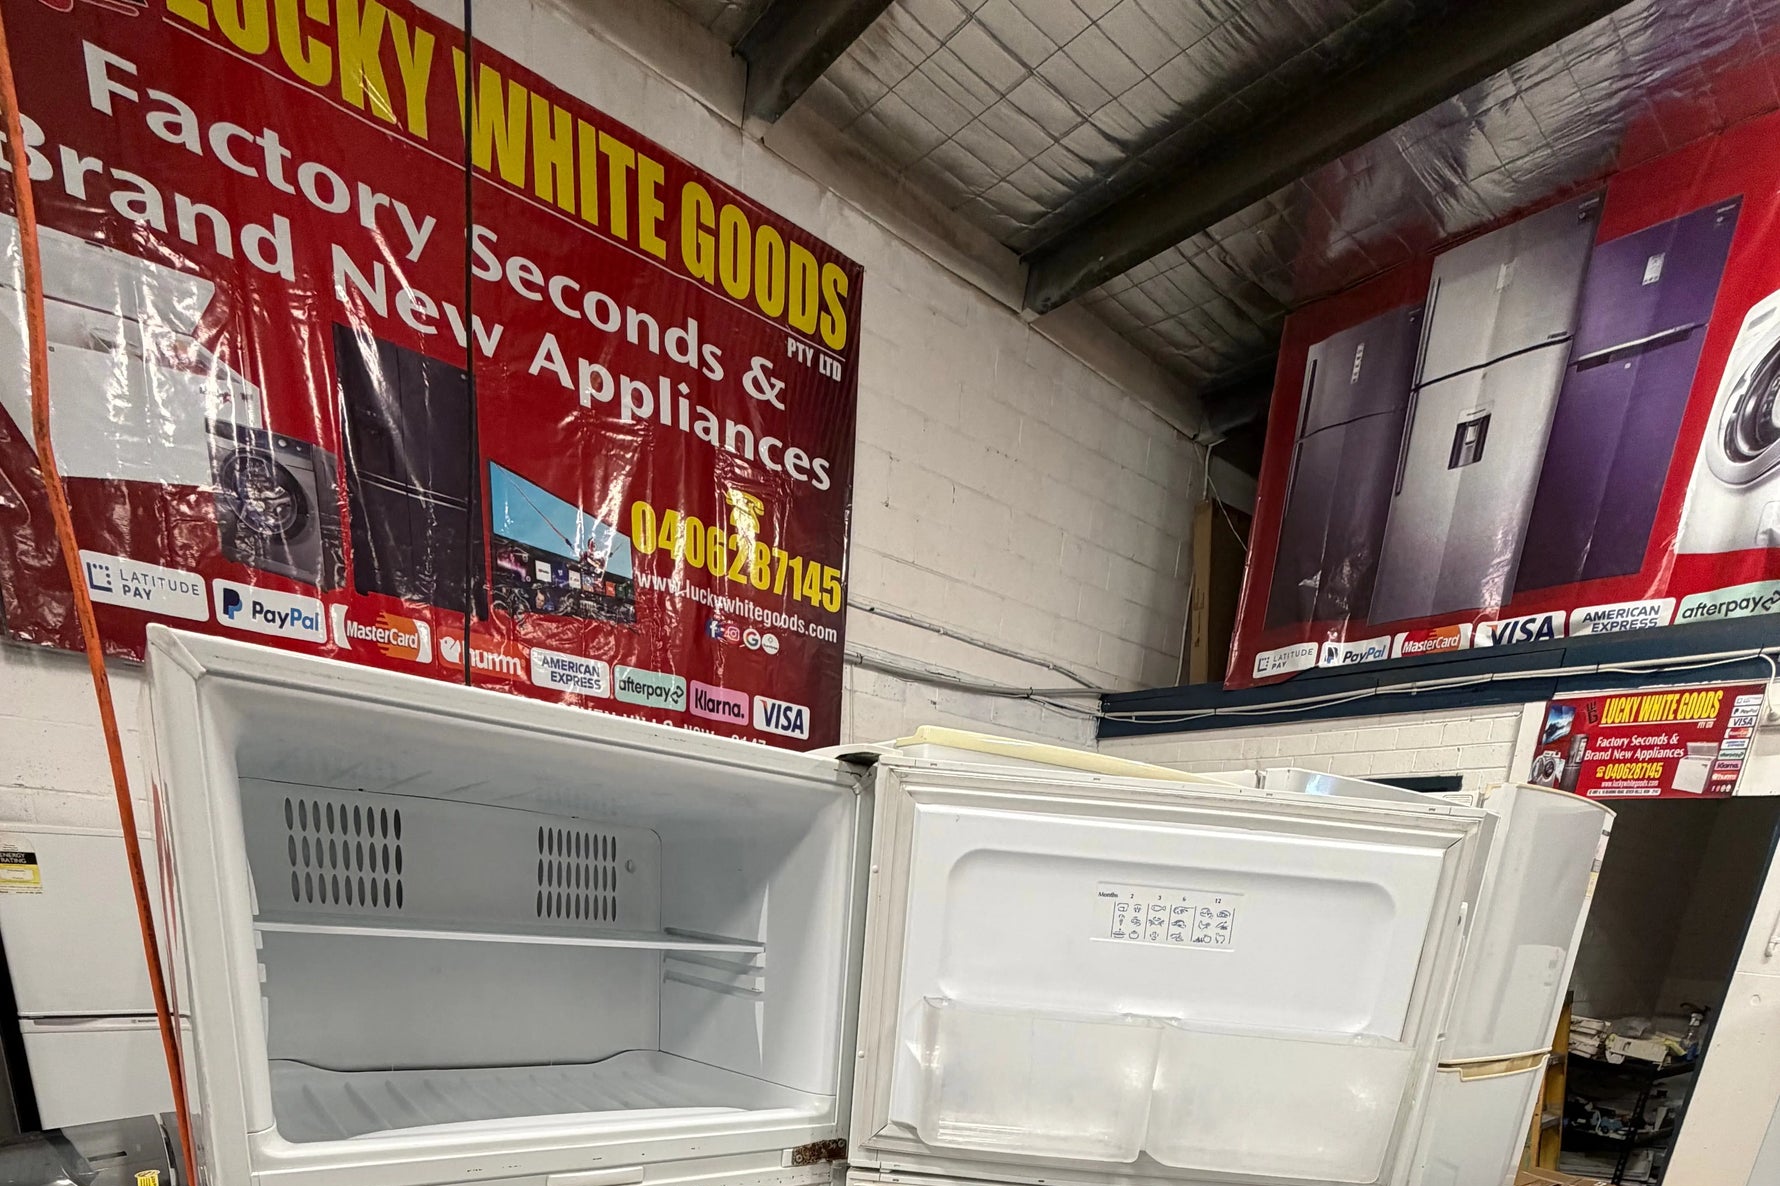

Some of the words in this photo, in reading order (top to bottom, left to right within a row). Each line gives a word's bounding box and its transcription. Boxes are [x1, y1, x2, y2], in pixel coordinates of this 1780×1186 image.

[166, 0, 435, 140] CKY
[452, 46, 666, 260] WHITE
[681, 181, 848, 350] GOODS
[82, 39, 437, 263] Factory
[465, 223, 725, 381] Seconds
[742, 355, 786, 410] &
[0, 111, 296, 282] Brand
[331, 243, 503, 358] New
[528, 333, 831, 490] Appliances
[787, 336, 814, 367] PTY
[819, 355, 842, 381] LTD
[631, 500, 842, 613] 0406287145
[120, 568, 200, 596] LATITUDE
[123, 584, 152, 601] PAY
[252, 600, 319, 631] PayPal
[636, 569, 837, 643] www.luckywhitegoods.com
[1582, 605, 1660, 623] AMERICAN
[1682, 594, 1763, 620] afterpay
[346, 621, 418, 649] MasterCard
[1489, 616, 1554, 645] VISA
[1591, 617, 1658, 633] EXPRESS
[1273, 648, 1313, 663] LATITUDE
[1343, 645, 1385, 664] PayPal
[1402, 635, 1460, 653] MasterCard
[541, 655, 601, 677] AMERICAN
[1271, 661, 1287, 671] PAY
[550, 671, 601, 690] EXPRESS
[619, 676, 671, 702] afterpay
[695, 688, 745, 719] Klarna.
[1600, 696, 1641, 724] LUCKY
[1638, 693, 1679, 722] WHITE
[1677, 690, 1723, 720] GOODS
[760, 700, 804, 734] VISA
[1733, 717, 1753, 726] VISA
[1596, 736, 1629, 749] Factory
[1630, 733, 1668, 746] Seconds
[1669, 733, 1679, 744] &
[1584, 749, 1611, 761] Brand
[1612, 748, 1632, 759] New
[1634, 746, 1685, 763] Appliances
[1604, 761, 1664, 779] 0406287145
